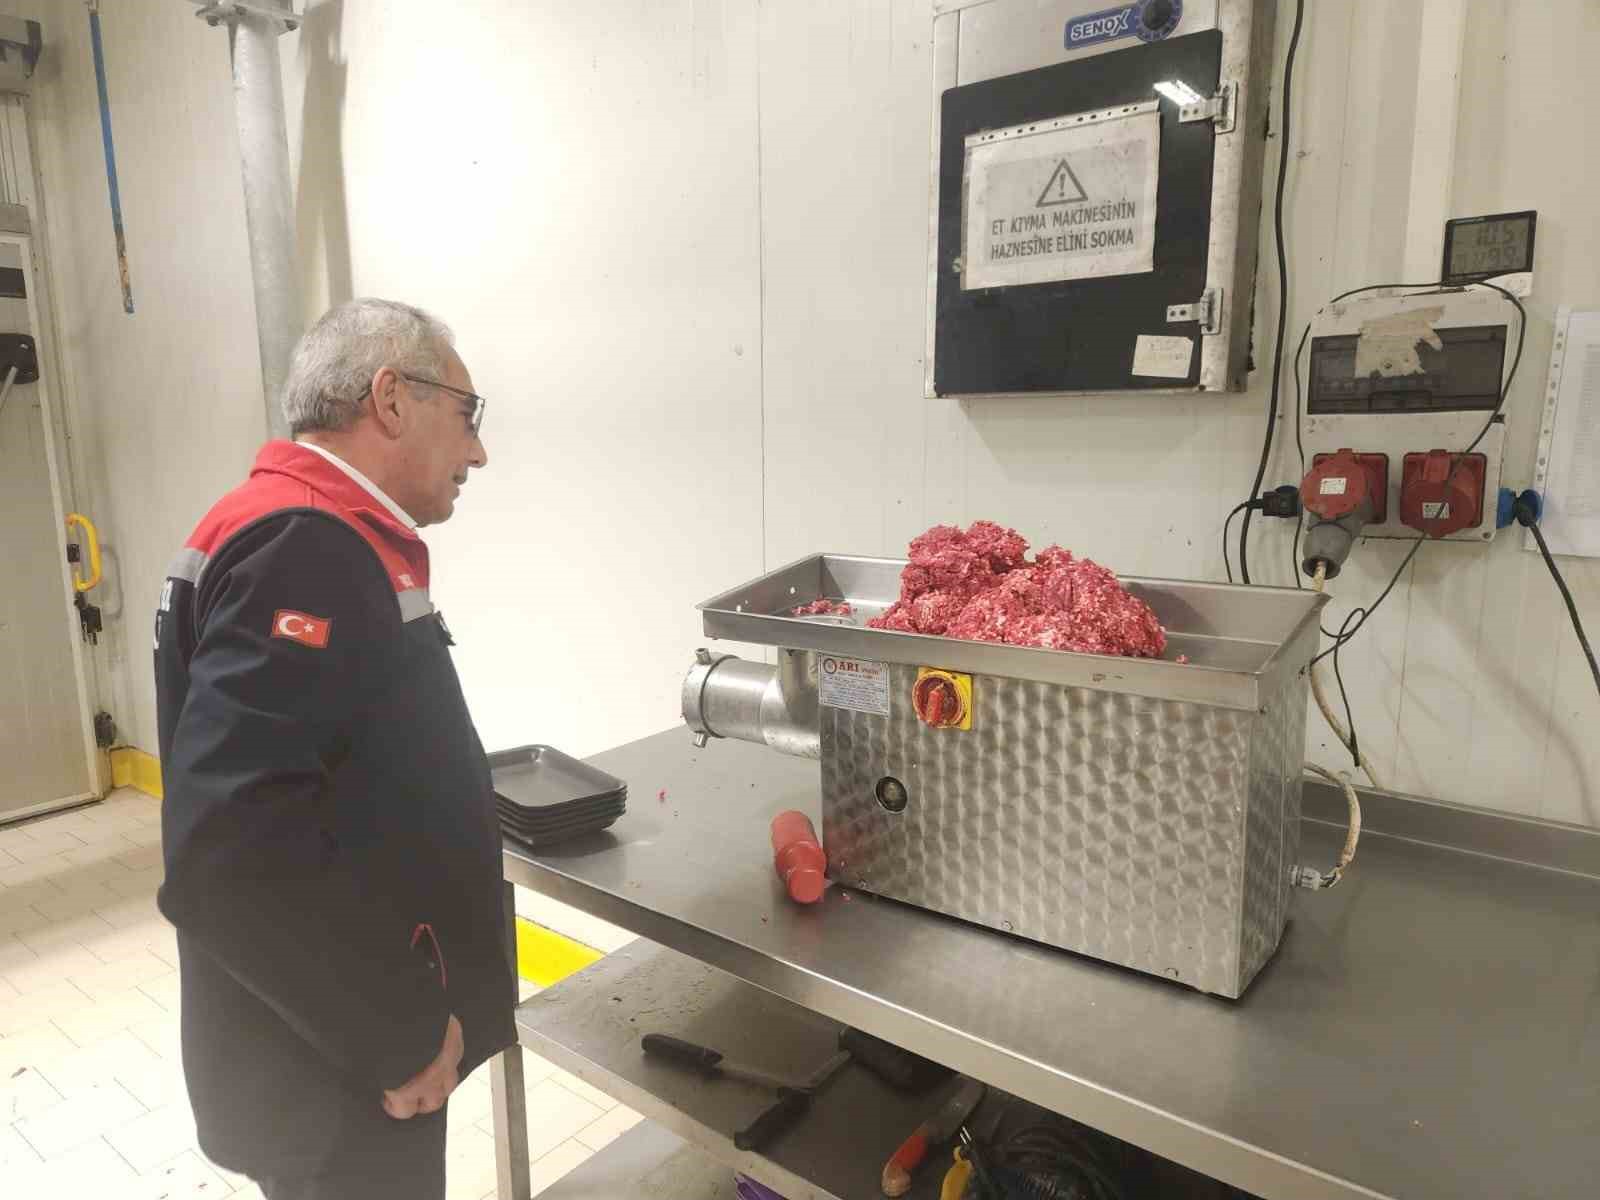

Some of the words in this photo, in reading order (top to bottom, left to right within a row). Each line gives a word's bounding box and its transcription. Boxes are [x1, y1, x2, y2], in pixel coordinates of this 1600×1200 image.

[1071, 8, 1131, 40] SENOX
[992, 218, 1006, 235] ET
[1010, 214, 1046, 233] KIYMA
[1052, 199, 1136, 228] MAKİNESİNİN
[991, 235, 1053, 260] HAZNESİNE
[1056, 229, 1088, 252] ELİNİ
[1090, 228, 1134, 249] SOKMA
